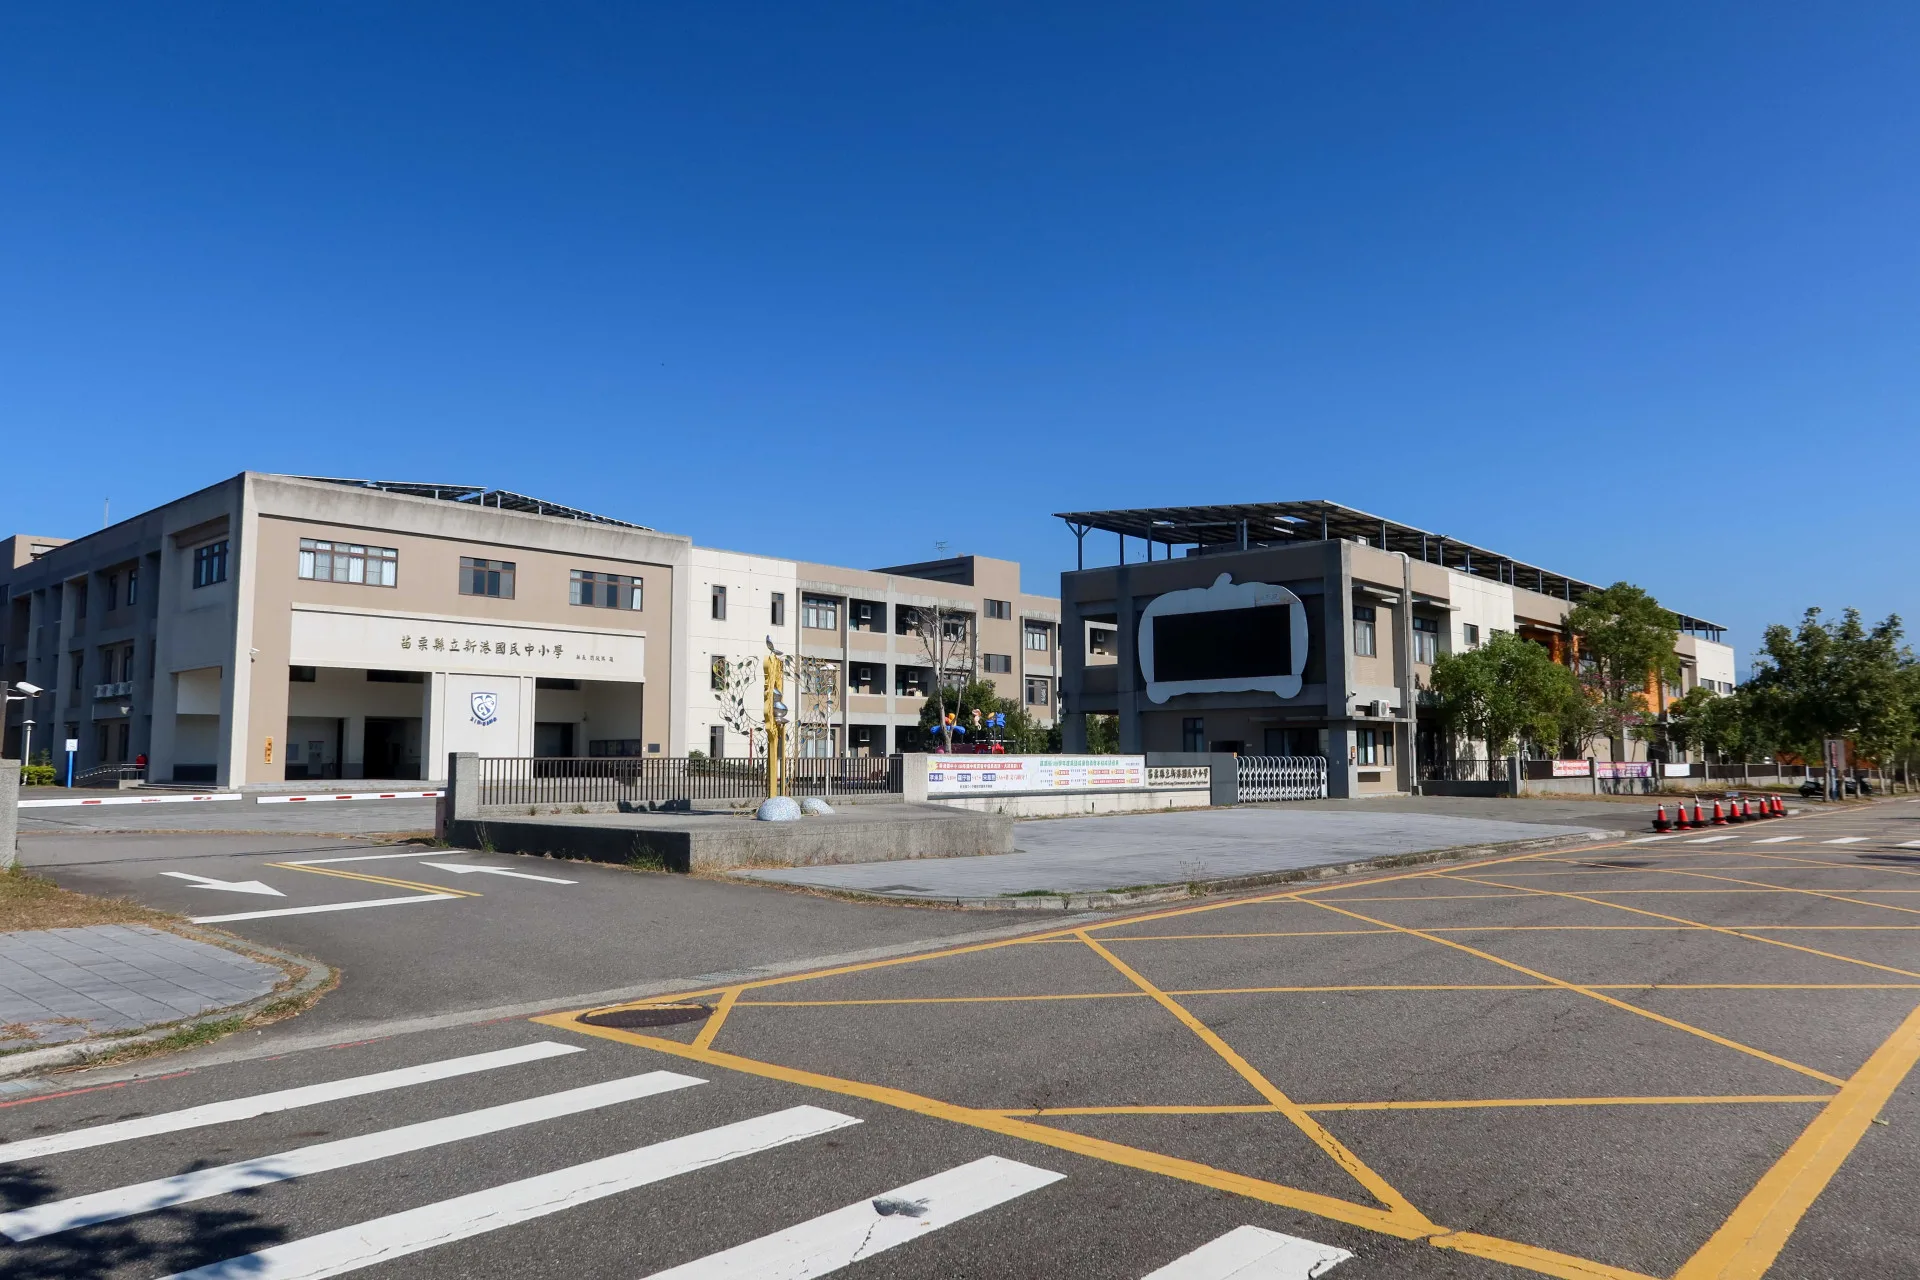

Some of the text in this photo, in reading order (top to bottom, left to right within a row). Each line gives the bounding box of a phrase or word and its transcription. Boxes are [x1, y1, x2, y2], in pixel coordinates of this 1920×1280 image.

[401, 635, 563, 659] 苗栗縣立新港國民中小學
